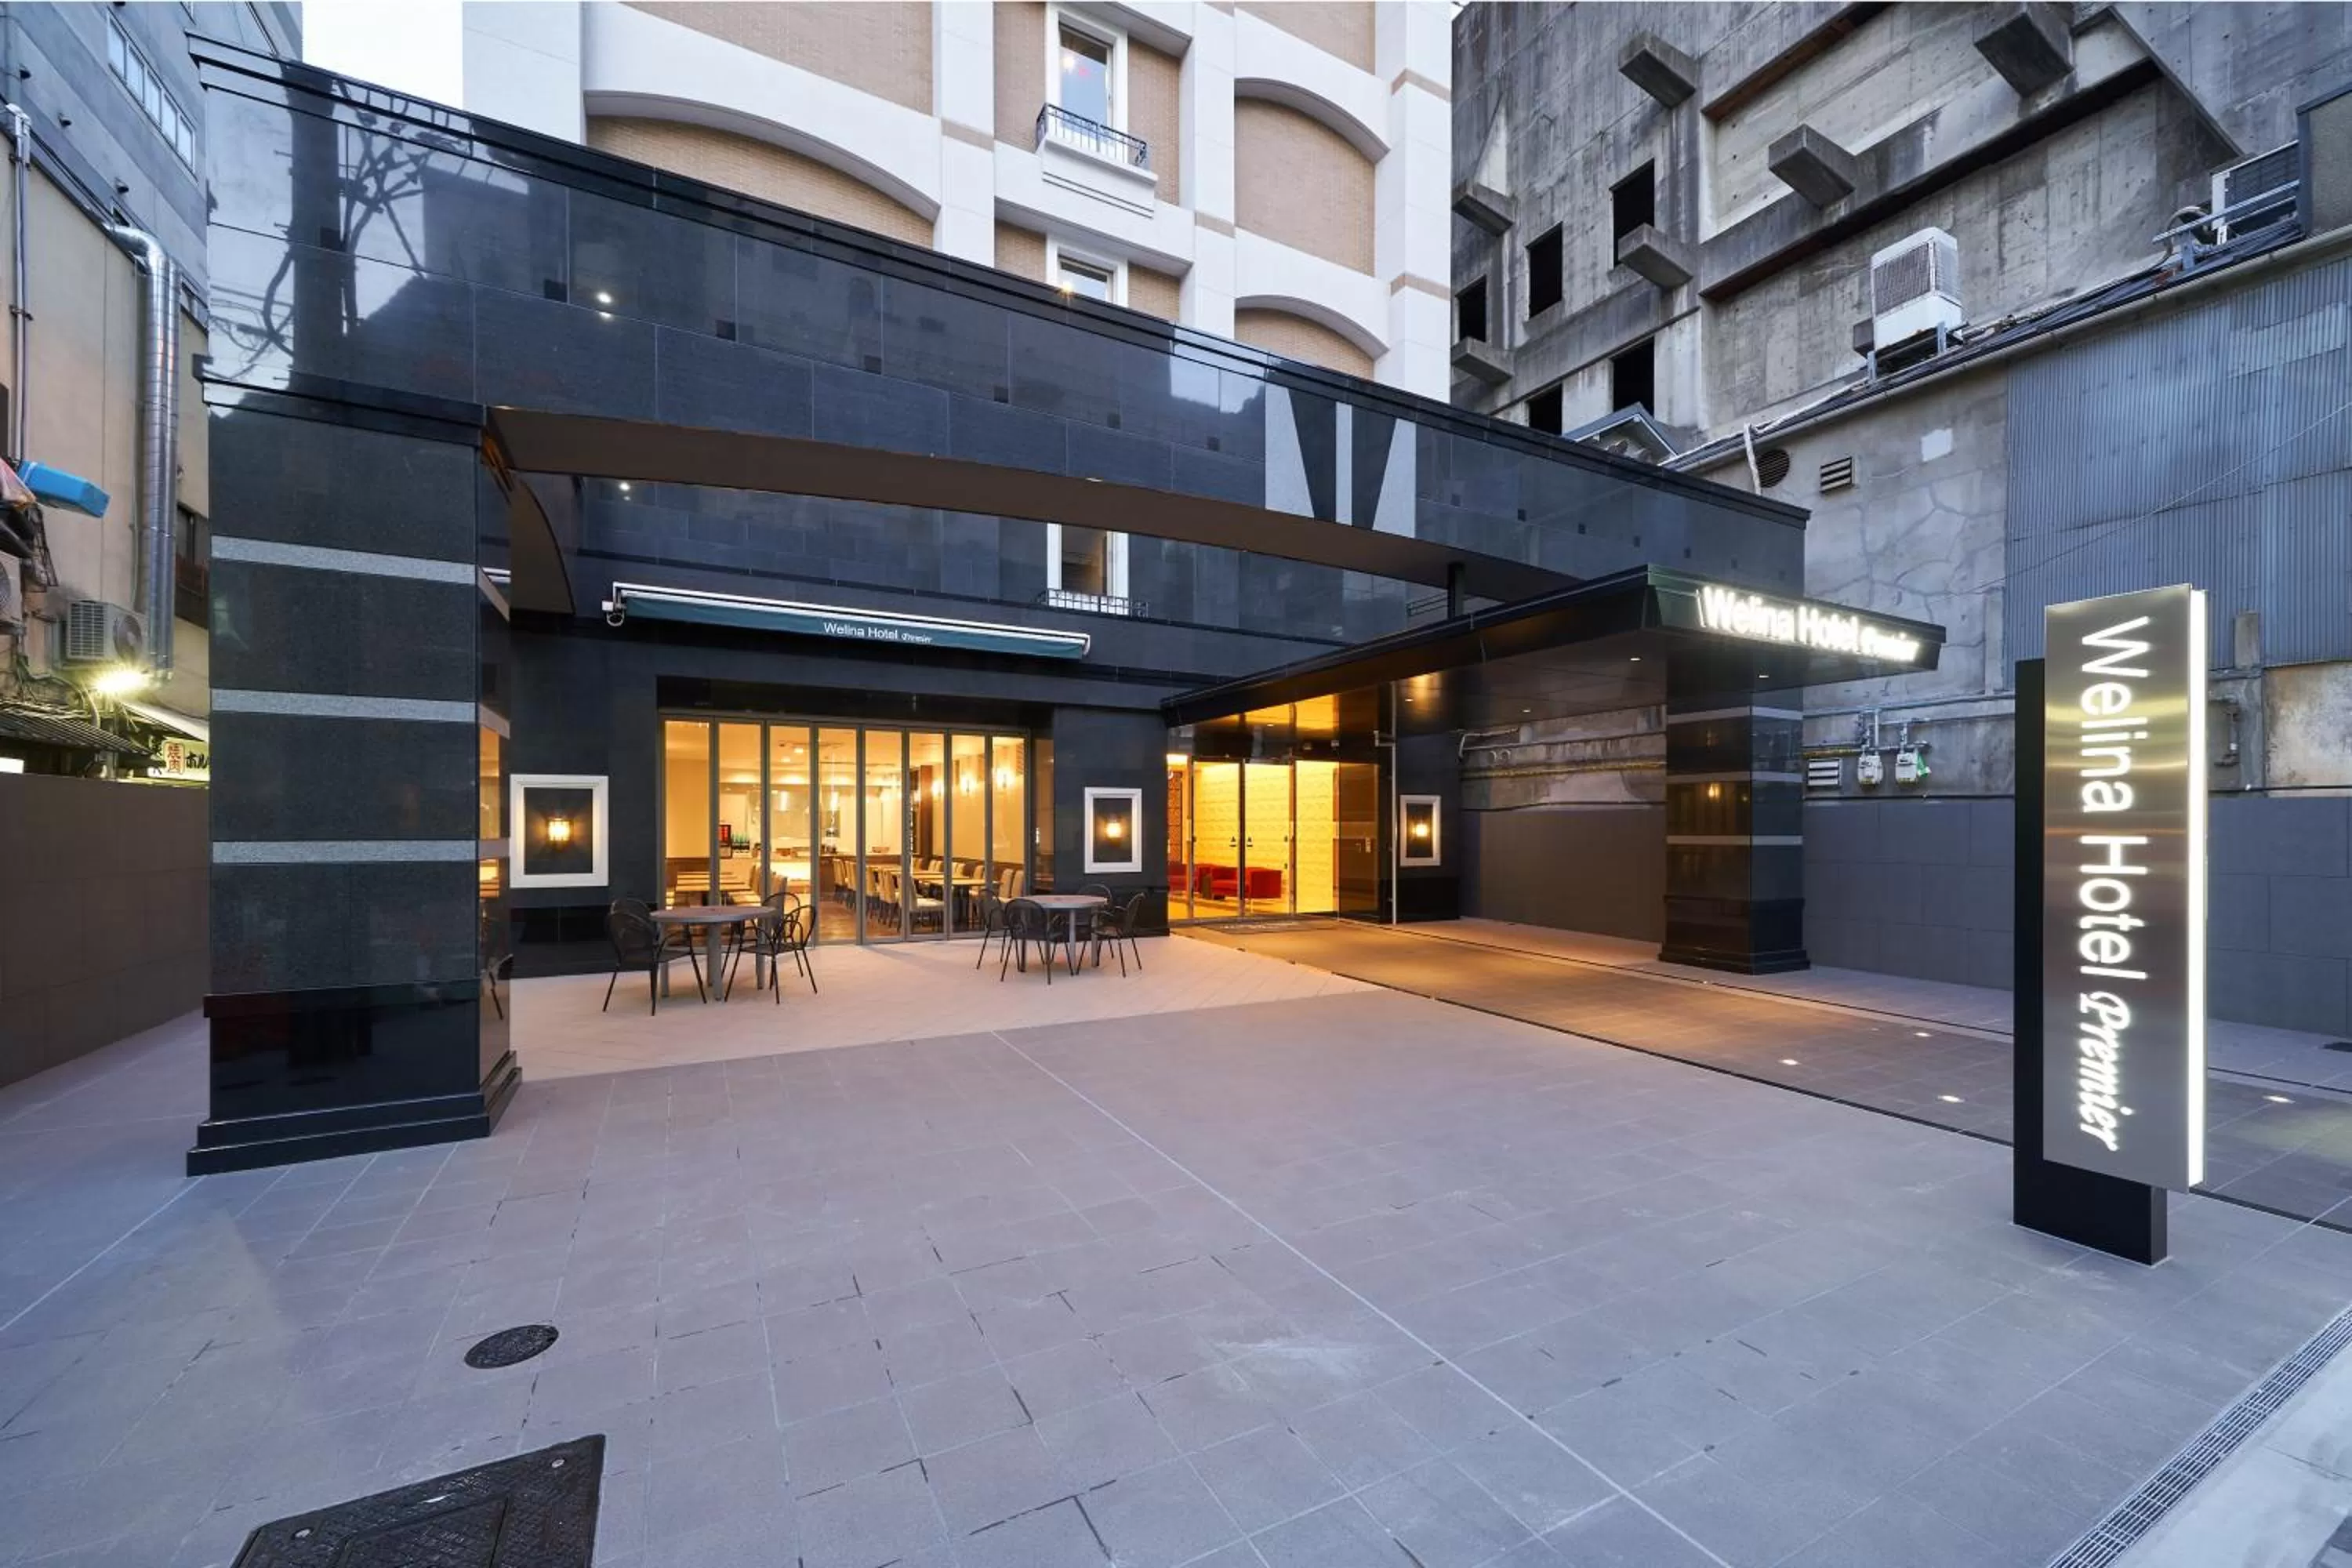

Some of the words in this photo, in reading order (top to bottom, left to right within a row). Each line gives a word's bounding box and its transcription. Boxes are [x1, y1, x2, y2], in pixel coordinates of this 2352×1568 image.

[823, 622, 865, 637] Welina
[867, 626, 898, 640] Hotel
[1695, 586, 1795, 643] Welina
[1797, 606, 1860, 654] Hotel
[2081, 615, 2151, 813] Welina
[2079, 835, 2148, 979] Hotel
[2079, 991, 2134, 1152] Premier
